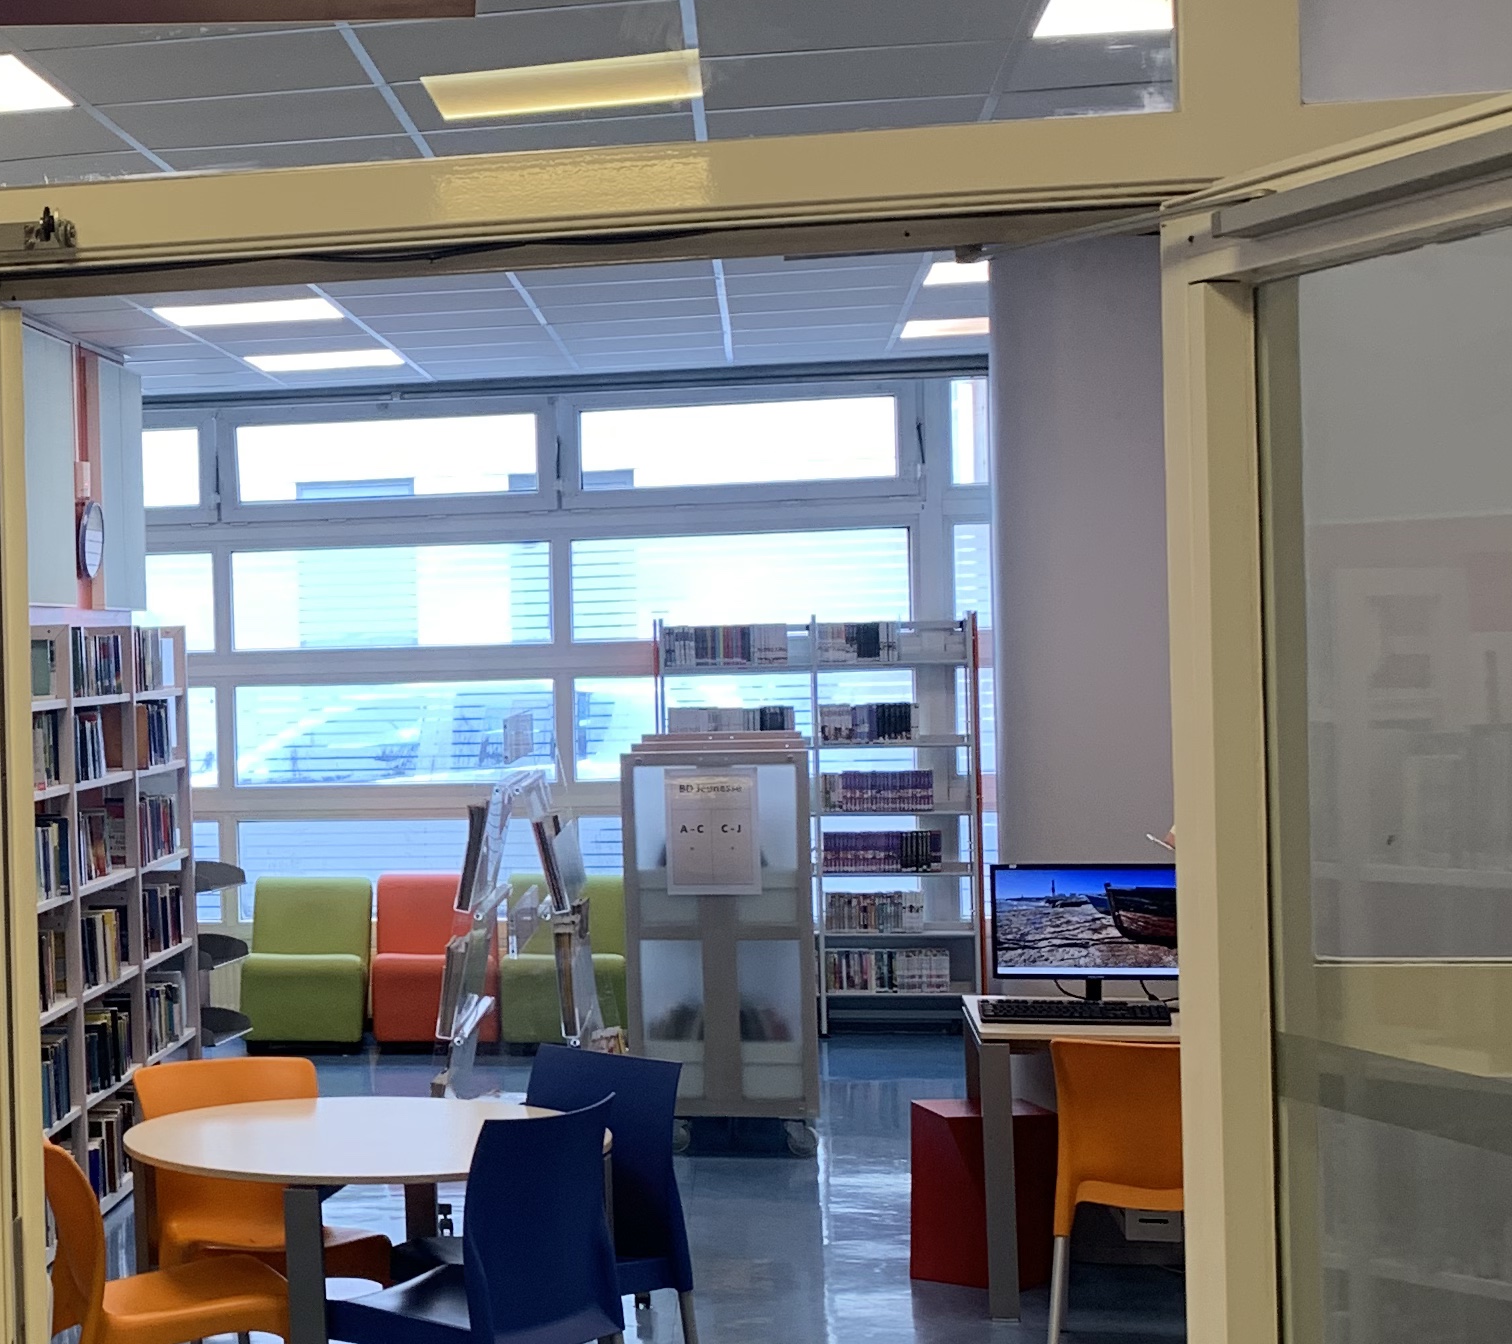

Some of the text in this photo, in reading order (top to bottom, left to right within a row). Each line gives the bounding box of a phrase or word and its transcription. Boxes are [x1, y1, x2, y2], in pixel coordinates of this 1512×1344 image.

[679, 784, 693, 793] BD
[680, 824, 688, 834] A
[696, 824, 704, 834] C
[721, 824, 728, 833] C
[736, 824, 742, 833] J
